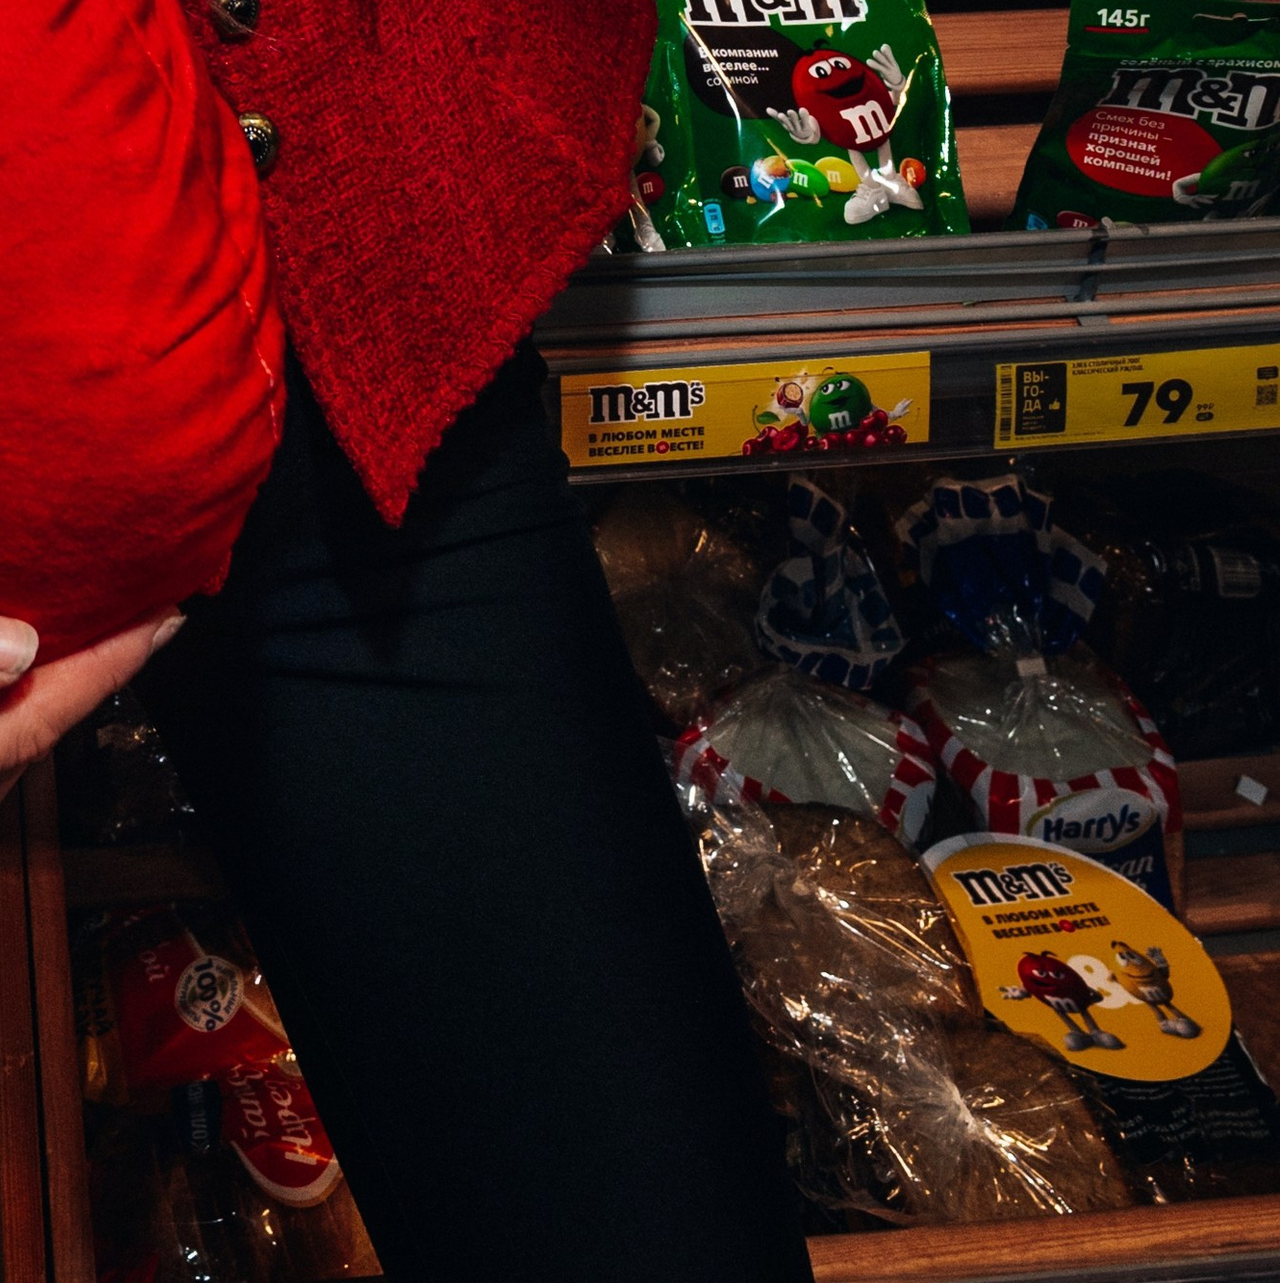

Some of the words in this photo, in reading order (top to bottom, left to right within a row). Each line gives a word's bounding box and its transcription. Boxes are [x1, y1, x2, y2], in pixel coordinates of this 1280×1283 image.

[1097, 8, 1151, 28] 145г
[711, 48, 779, 58] компании
[841, 100, 892, 145] m
[1095, 111, 1135, 124] Смех
[1138, 116, 1166, 130] без
[1091, 122, 1159, 141] причины
[1089, 132, 1157, 153] признак
[1086, 143, 1161, 166] хорошей
[1083, 155, 1172, 181] компании!
[1023, 370, 1049, 384] ВЫ-
[1072, 365, 1119, 375] КЛАССИЧЕСКИЙ
[1023, 385, 1044, 398] ГО-
[1022, 399, 1042, 414] ДА
[1122, 378, 1193, 427] 79
[828, 410, 852, 430] m
[600, 429, 657, 443] ЛЮБОМ
[661, 426, 705, 440] МЕСТЕ
[588, 443, 645, 457] ВЕСЕЛЕЕ
[997, 909, 1052, 925] ЛЮБОМ
[1056, 902, 1100, 918] МЕСТЕ
[992, 923, 1052, 940] ВЕСЕЛЕЕ
